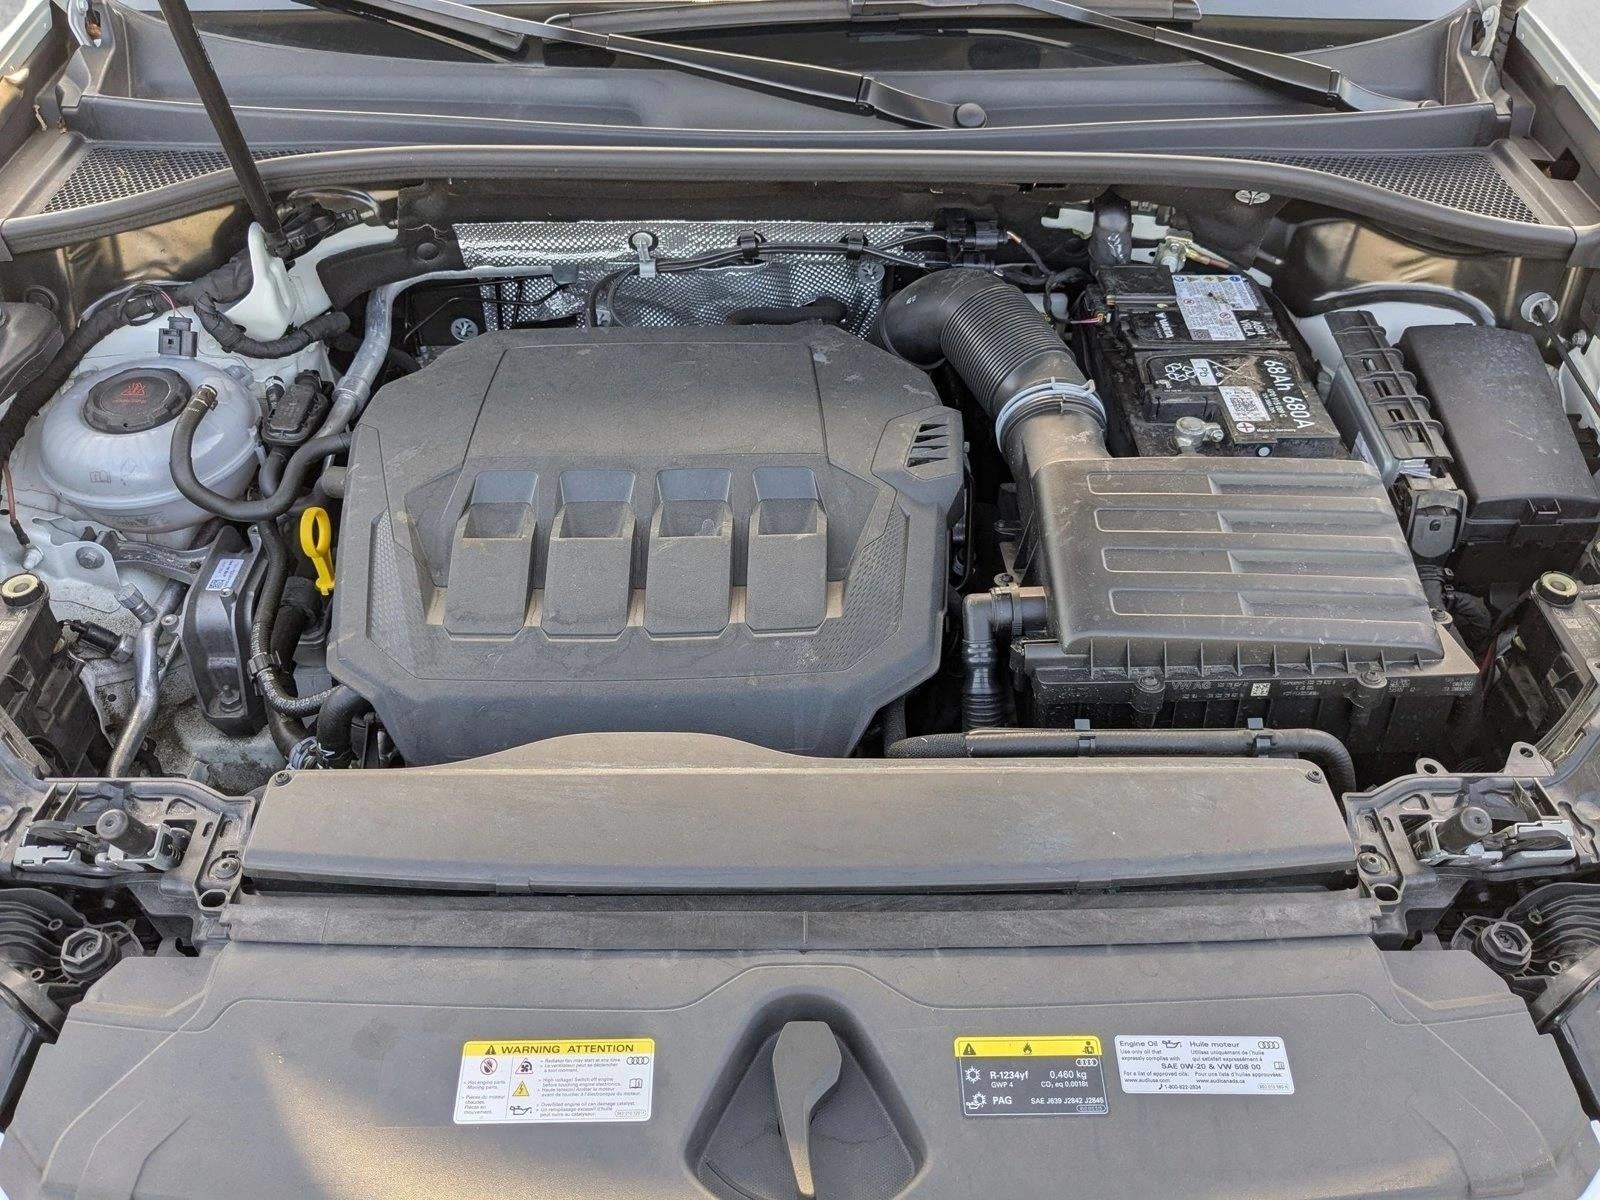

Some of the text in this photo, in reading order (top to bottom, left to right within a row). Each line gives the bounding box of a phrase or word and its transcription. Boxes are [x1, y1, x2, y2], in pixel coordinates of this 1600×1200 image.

[1240, 319, 1256, 336] VRLA
[1250, 319, 1268, 335] AGM
[1196, 366, 1208, 377] Pb
[1263, 360, 1295, 391] 68Ah
[1282, 396, 1315, 429] 680A
[501, 1044, 634, 1054] WARNING ATTENTION
[989, 1070, 1029, 1080] R-1234yf
[1076, 1070, 1087, 1080] kg
[992, 1096, 1012, 1105] PAG
[1084, 1096, 1104, 1104] J2845
